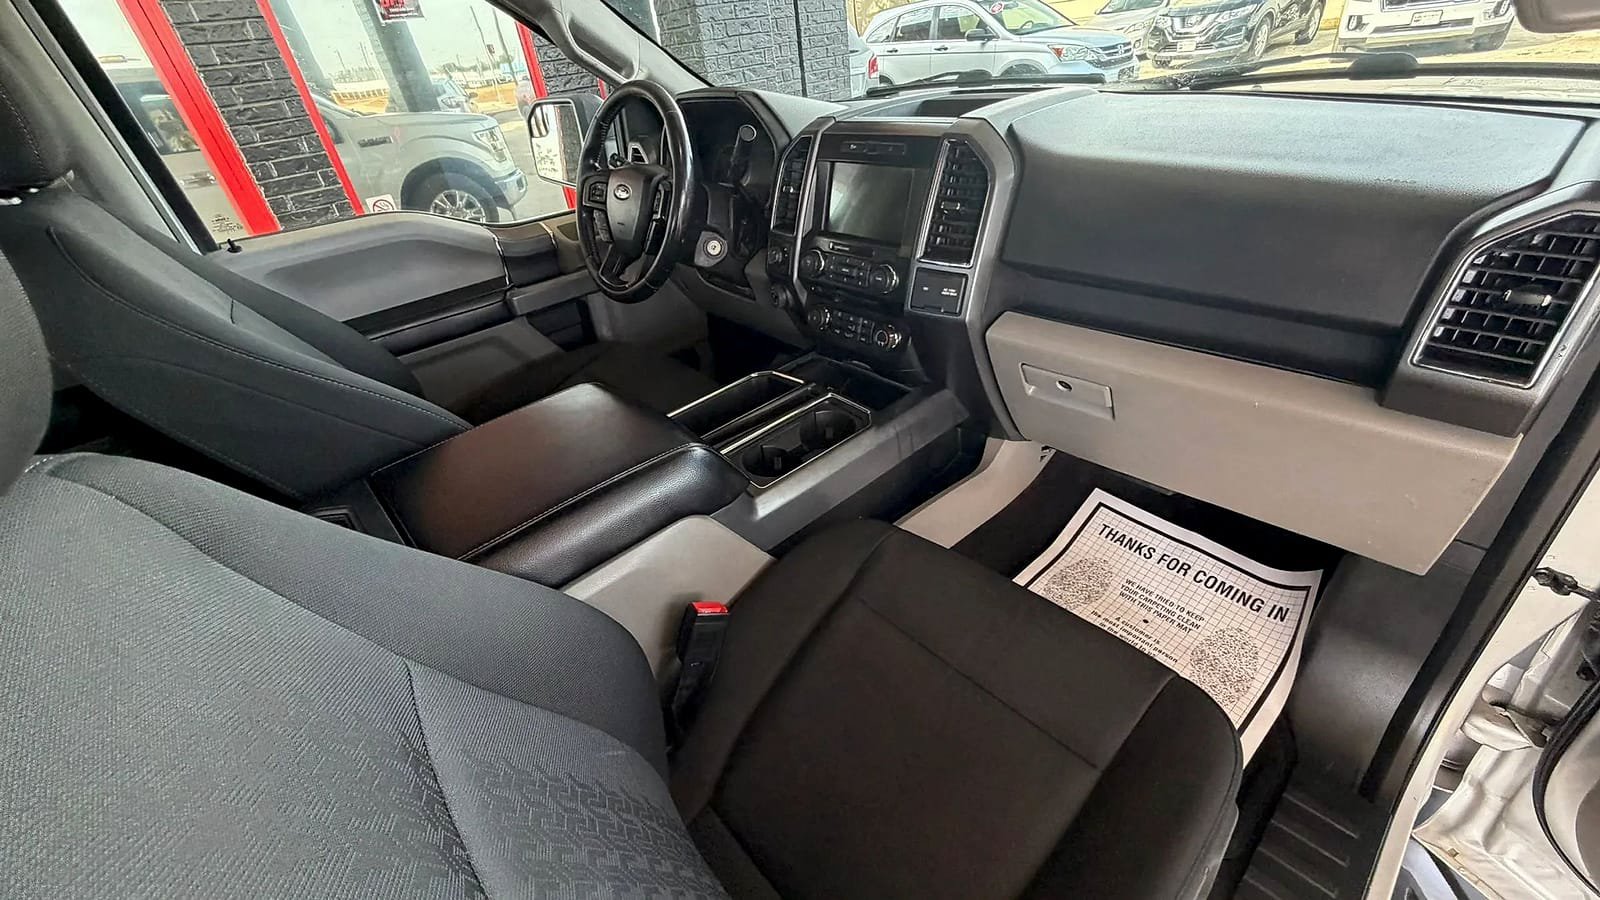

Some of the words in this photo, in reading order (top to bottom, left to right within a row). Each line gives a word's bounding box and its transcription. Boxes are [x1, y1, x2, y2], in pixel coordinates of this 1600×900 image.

[1098, 523, 1156, 561] THANKS
[1157, 553, 1192, 578] FOR
[1193, 570, 1265, 613] COMING
[1268, 605, 1290, 623] IN
[1119, 591, 1138, 604] WITH
[1136, 601, 1154, 613] THIS
[1153, 610, 1176, 626] PAPER
[1175, 622, 1192, 634] MAT
[1120, 584, 1139, 597] YOUR
[1139, 594, 1177, 617] CARPETING
[1176, 614, 1201, 630] CLEAN
[1125, 579, 1137, 588] WE
[1138, 584, 1155, 596] HAVE
[1155, 594, 1175, 608] TRIED
[1175, 604, 1186, 613] TO
[1186, 610, 1205, 622] KEEP
[1120, 626, 1153, 648] important
[1152, 646, 1178, 663] person
